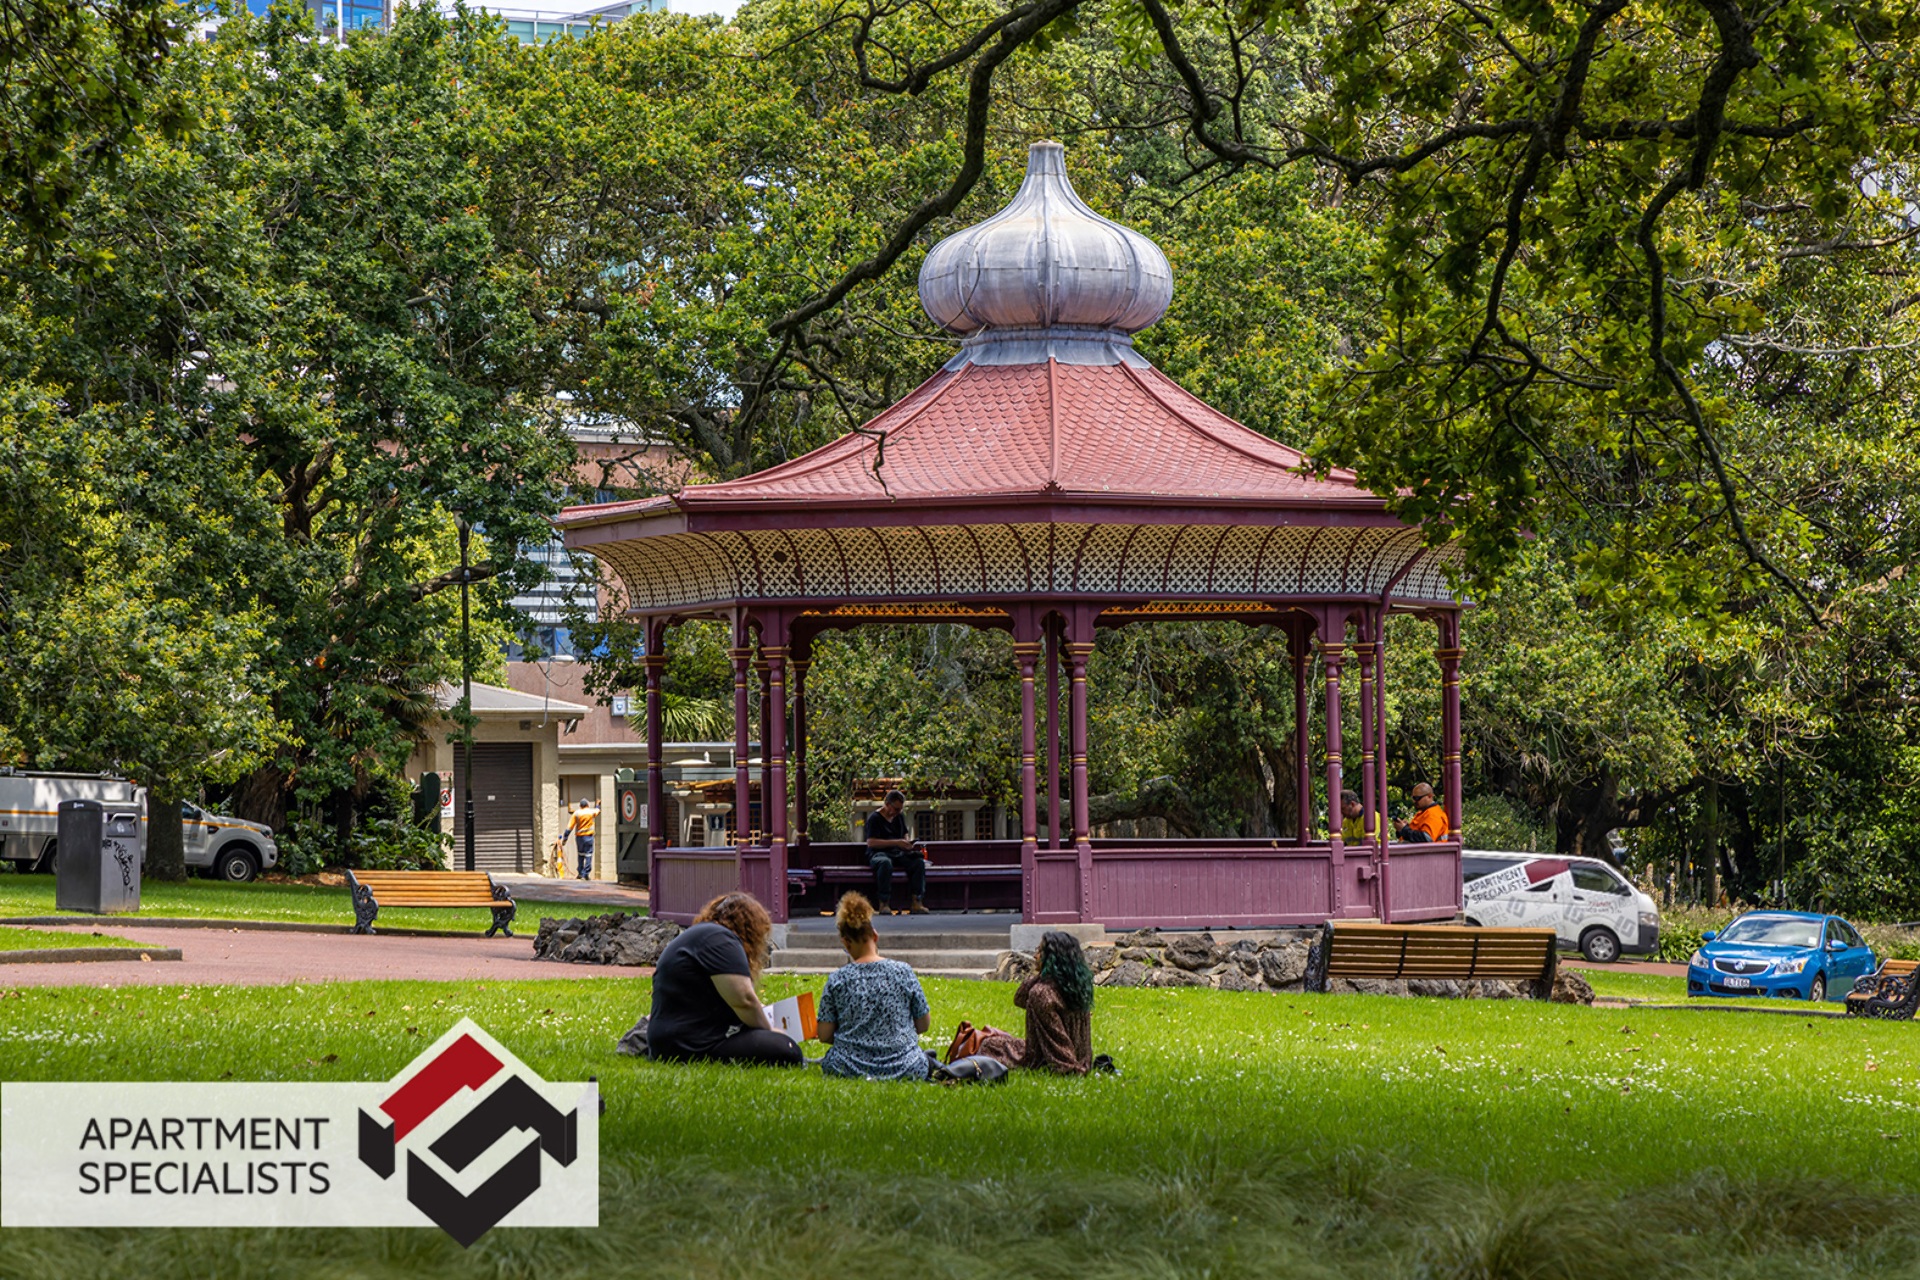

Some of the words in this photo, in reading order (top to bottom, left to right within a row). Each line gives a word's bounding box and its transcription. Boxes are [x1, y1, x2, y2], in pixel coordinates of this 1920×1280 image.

[626, 797, 633, 815] 5
[1468, 866, 1523, 894] APARTMENT
[1471, 877, 1530, 904] SPECIALISTS
